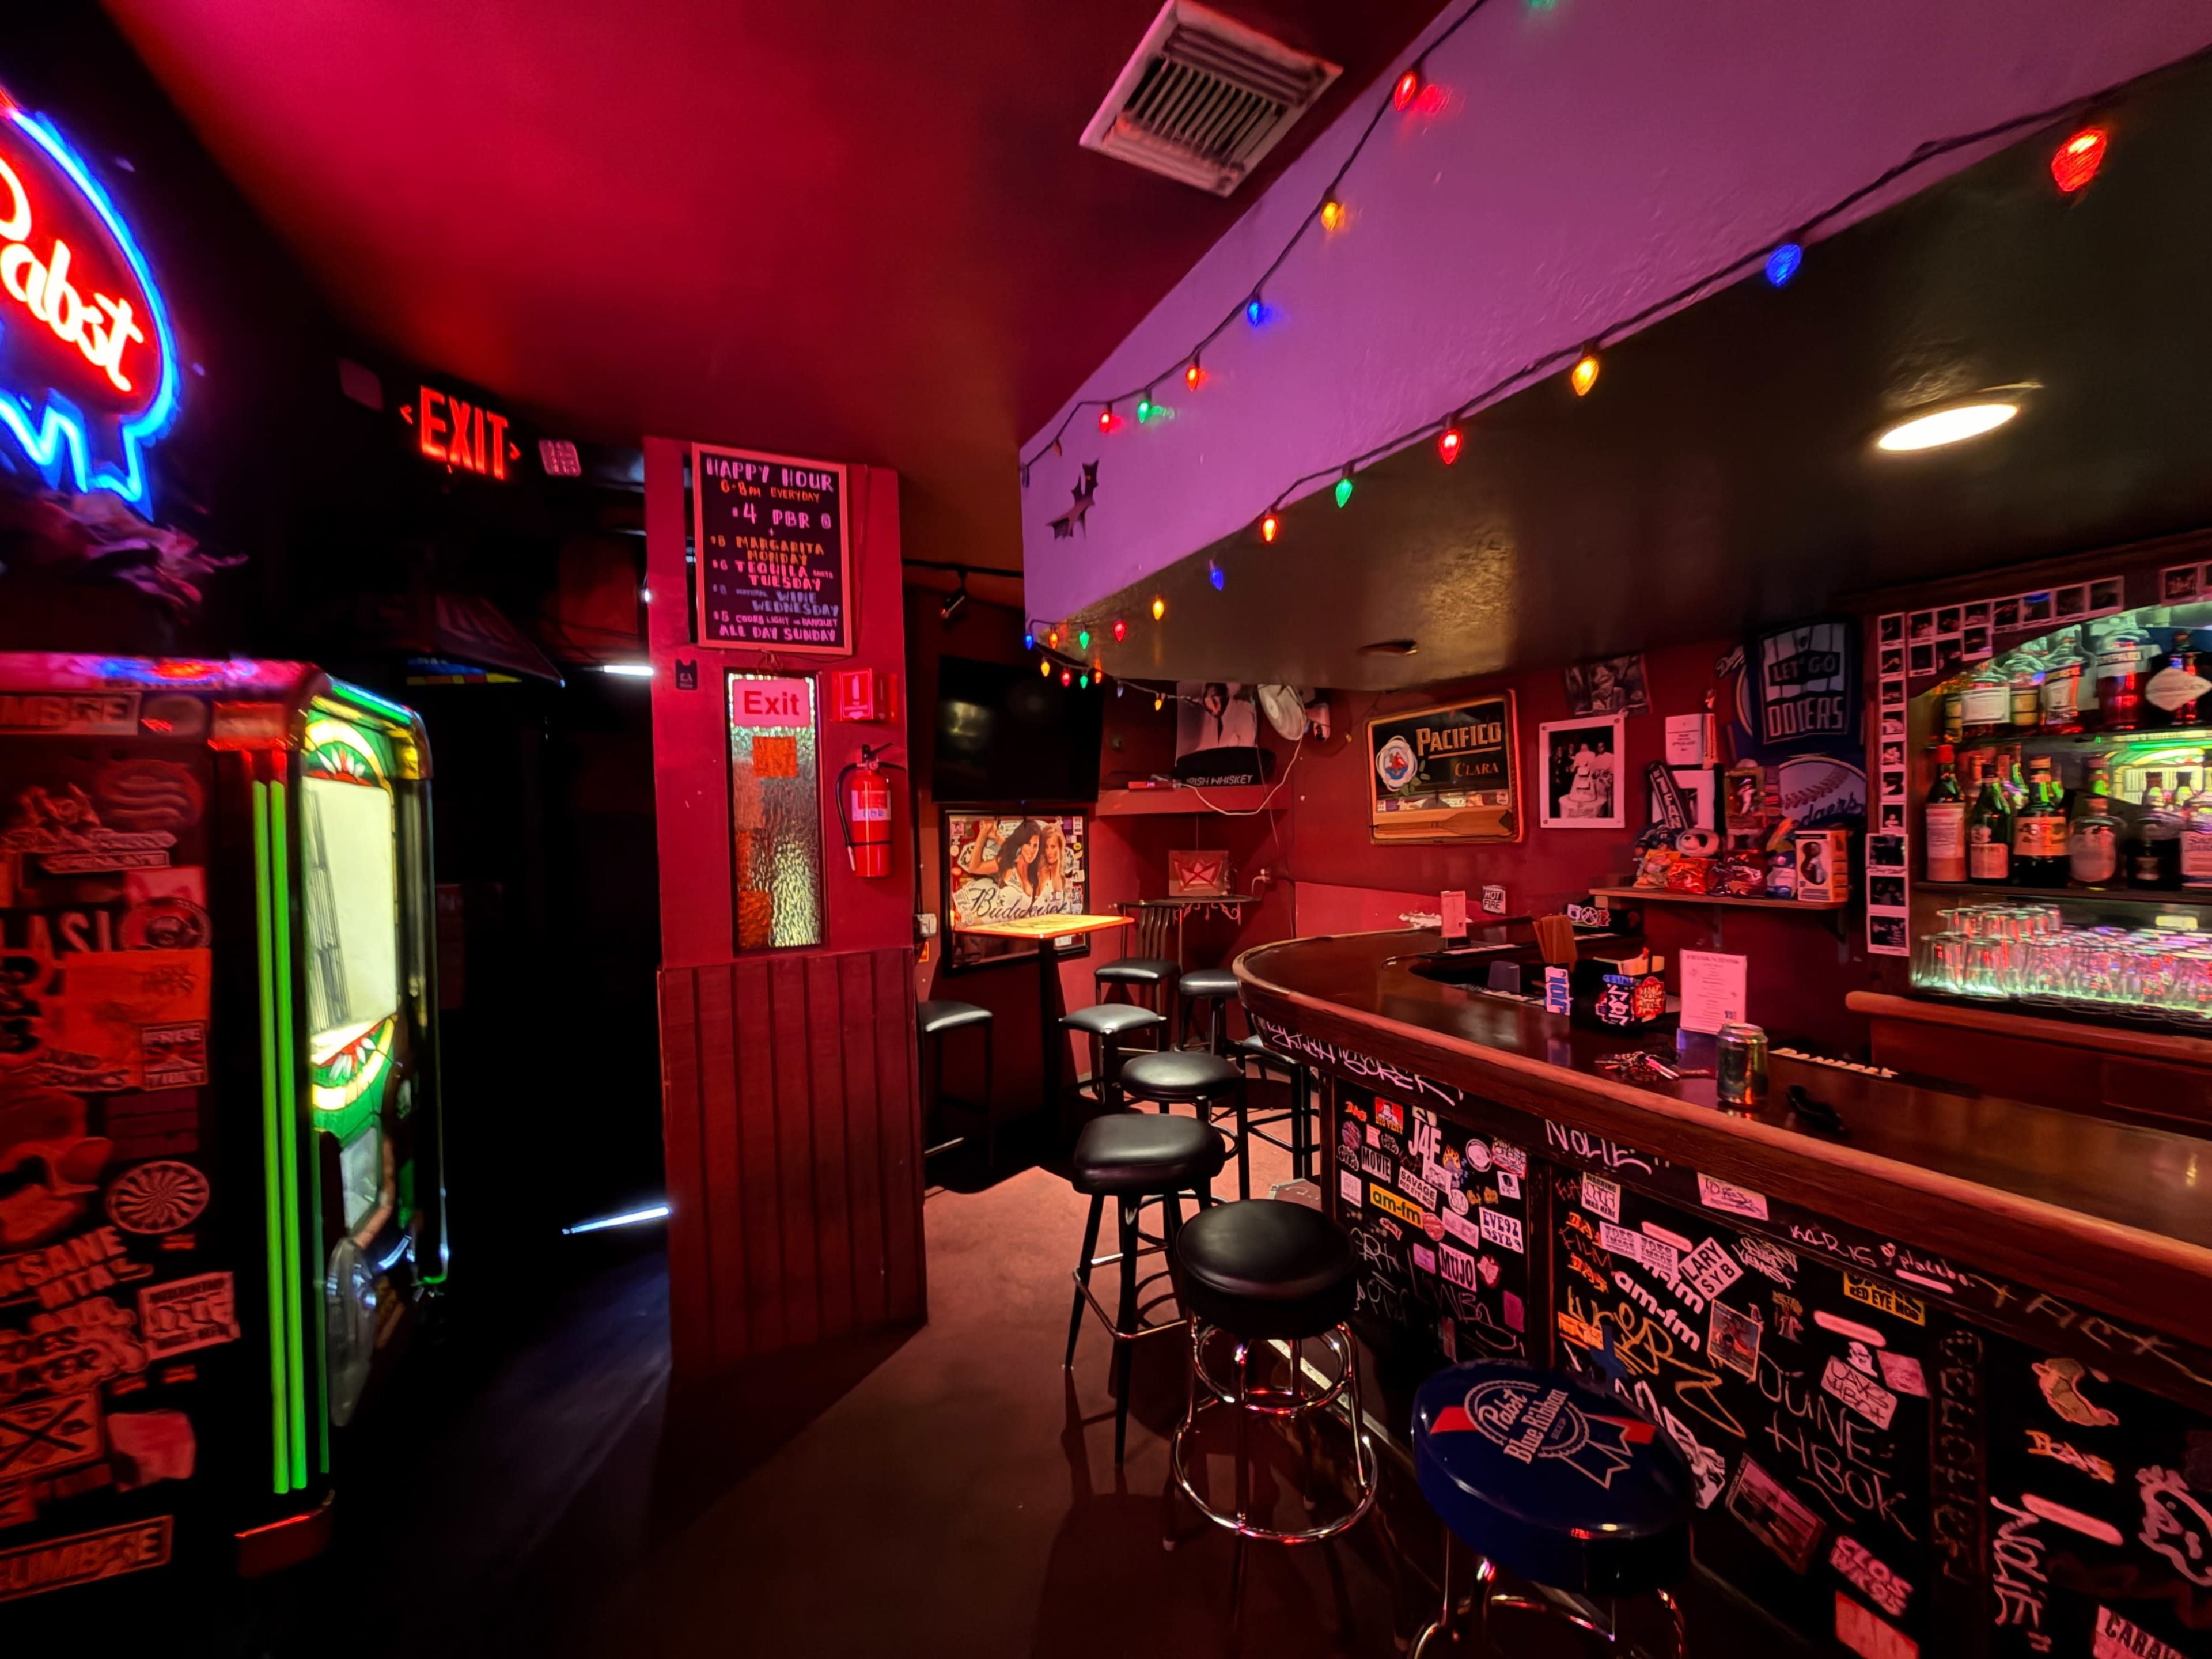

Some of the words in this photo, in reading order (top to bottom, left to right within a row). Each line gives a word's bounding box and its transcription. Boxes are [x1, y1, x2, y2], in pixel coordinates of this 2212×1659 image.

[420, 385, 509, 480] EXIT
[706, 457, 770, 483] HAPPY
[782, 468, 834, 493] HOUR
[771, 487, 819, 503] EVERYDAY
[772, 509, 810, 529] PBR
[736, 536, 824, 556] MARGARITA
[747, 550, 808, 566] MONDAY
[734, 560, 808, 578] TEQUILA
[749, 575, 821, 592] TUESDAY
[776, 591, 816, 604] WINE
[752, 600, 839, 616] WEDNESDAY
[736, 615, 764, 624] COORS
[767, 616, 789, 626] LIGHT
[802, 618, 838, 627] BANQUET
[720, 624, 746, 637] ALL
[753, 626, 777, 639] DAY
[784, 628, 835, 642] SUNDAY
[1807, 654, 1836, 674] GO
[744, 691, 800, 716] Exit
[1211, 774, 1253, 785] WHISKEY
[1484, 900, 1501, 910] FIRE
[1362, 1146, 1391, 1177] MOVIE
[1400, 1171, 1435, 1200] SAVAGE
[1372, 1190, 1422, 1224] am-fm
[1441, 1247, 1475, 1289] MUJO
[1683, 1241, 1722, 1281] LARY
[1873, 1291, 1892, 1309] EYE
[1611, 1270, 1701, 1352] am-fm
[1478, 1387, 1528, 1432] Pabst
[1521, 1388, 1569, 1437] Ribbon
[1503, 1427, 1545, 1465] Blue
